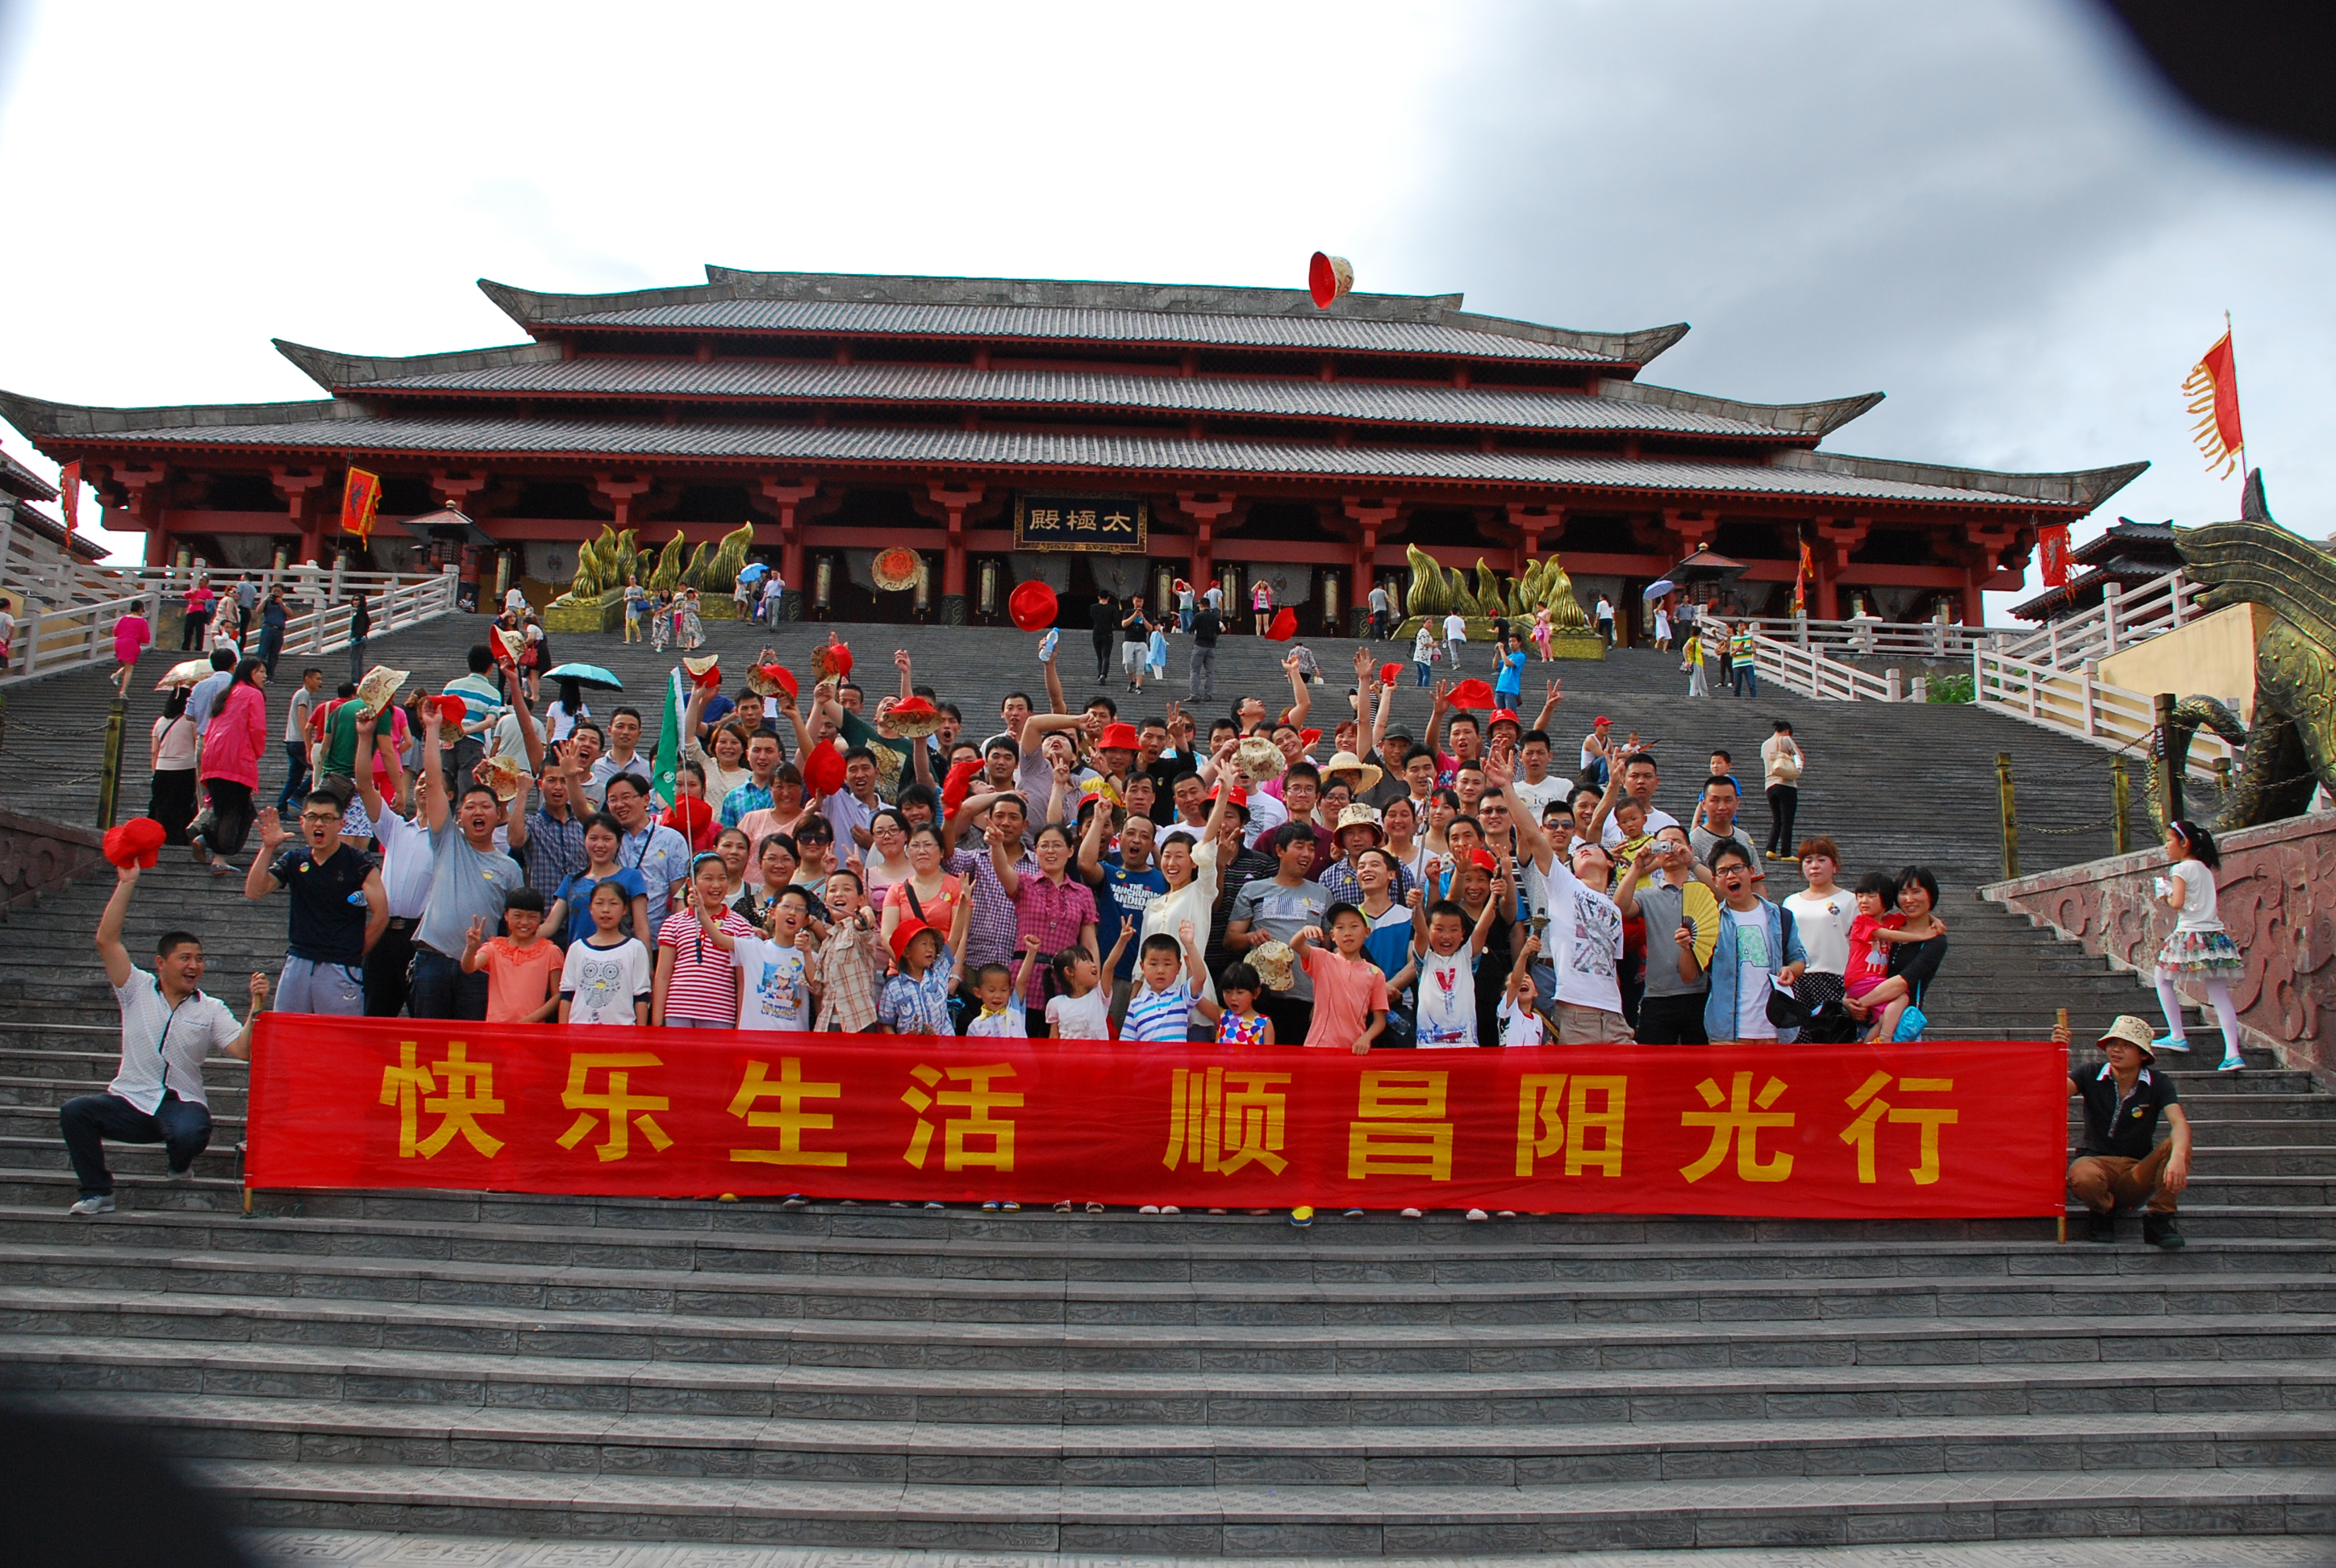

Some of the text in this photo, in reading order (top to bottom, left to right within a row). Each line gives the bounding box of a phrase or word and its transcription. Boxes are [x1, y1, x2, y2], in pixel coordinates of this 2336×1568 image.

[1736, 924, 1771, 967] A
[380, 1041, 1958, 1185] 快乐生活 顺昌阳光行
